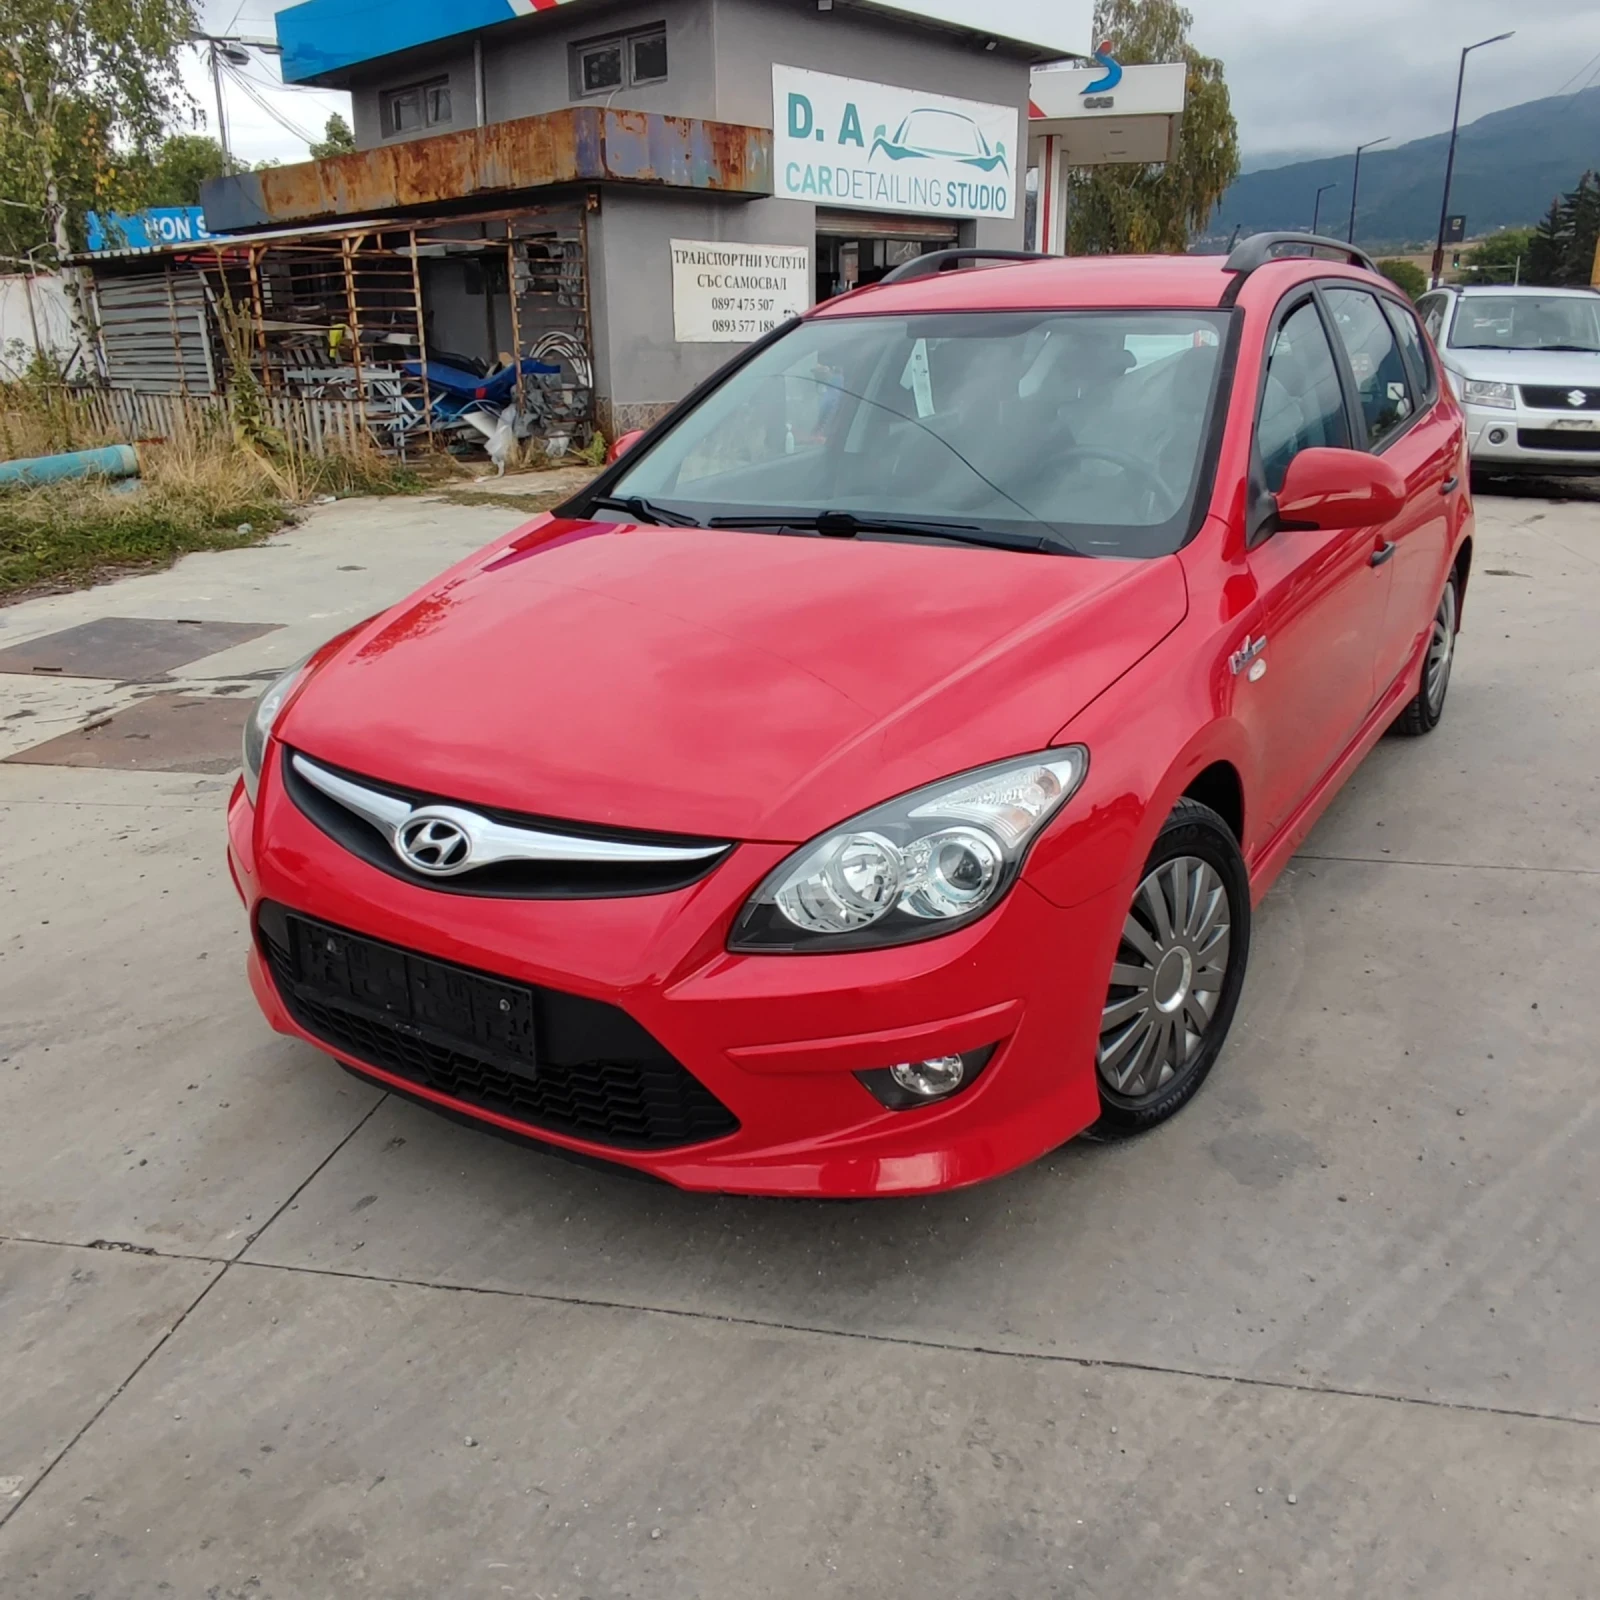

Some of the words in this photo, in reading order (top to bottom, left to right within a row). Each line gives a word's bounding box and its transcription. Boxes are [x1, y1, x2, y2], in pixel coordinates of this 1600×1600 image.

[787, 92, 824, 142] D.
[838, 102, 865, 148] A
[946, 181, 1007, 212] STUDIO
[673, 249, 762, 268] ТРАНСПОРТНИ
[764, 255, 806, 270] УСЛУГИ
[697, 273, 722, 288] СЪС
[724, 274, 787, 291] САМОСВАЛ
[711, 297, 735, 311] 0897
[736, 298, 756, 311] 475
[757, 298, 774, 311] 507
[712, 319, 736, 333] 0893
[739, 319, 756, 333] 577
[758, 320, 775, 333] 188
